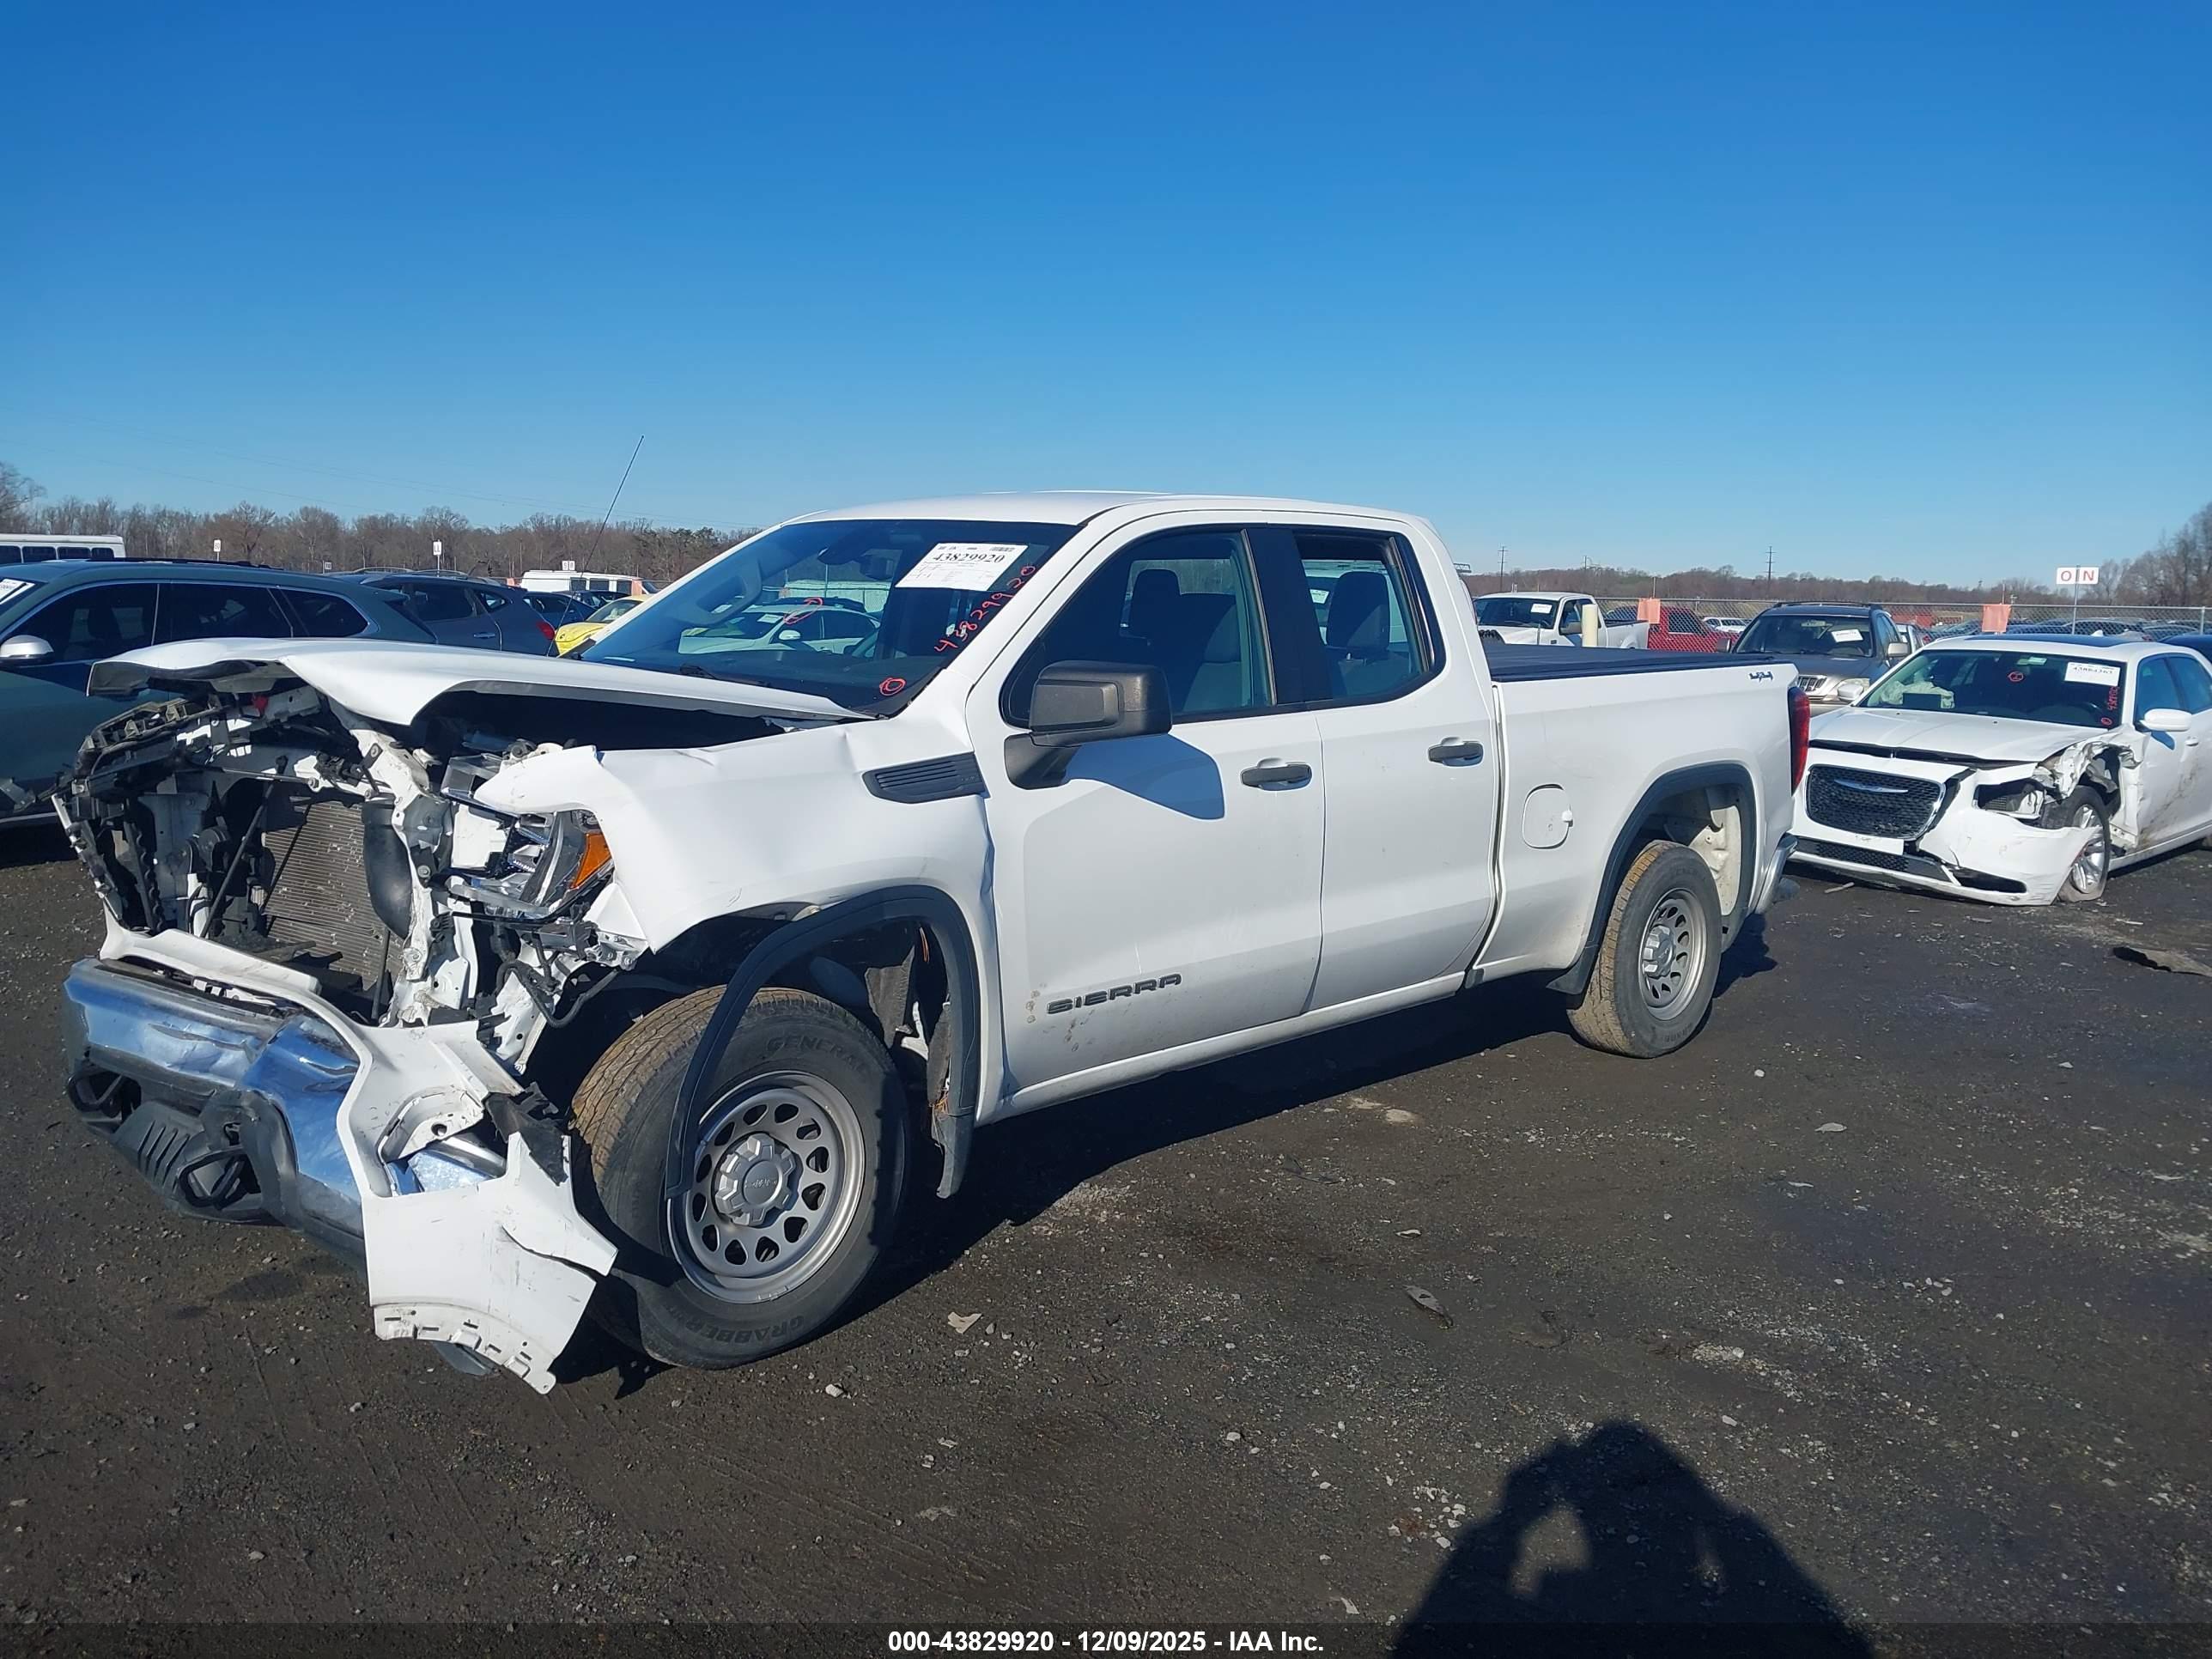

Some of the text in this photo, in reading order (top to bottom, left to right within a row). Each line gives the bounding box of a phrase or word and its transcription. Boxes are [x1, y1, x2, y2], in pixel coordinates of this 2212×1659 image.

[933, 552, 1006, 563] 43829920
[933, 565, 1036, 652] 43829920
[1047, 973, 1182, 1014] SIERRA
[685, 1315, 805, 1344] GRABBER
